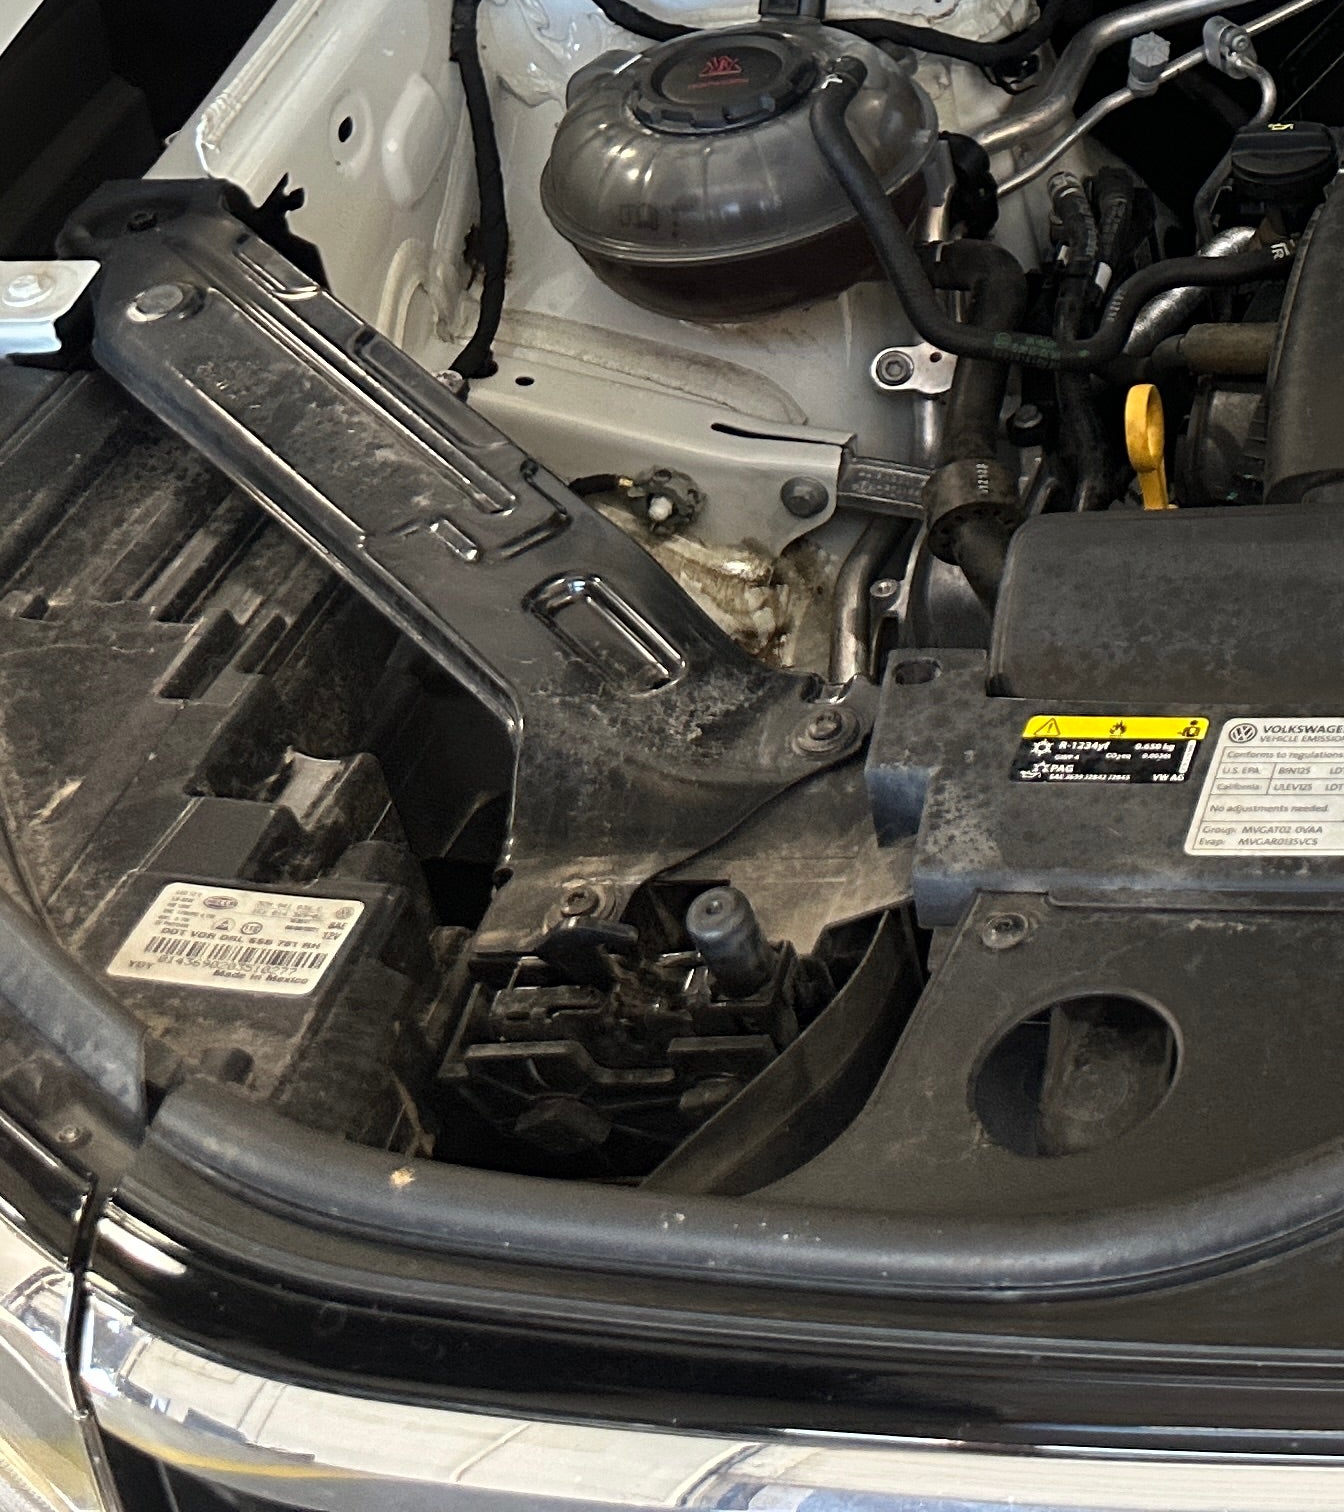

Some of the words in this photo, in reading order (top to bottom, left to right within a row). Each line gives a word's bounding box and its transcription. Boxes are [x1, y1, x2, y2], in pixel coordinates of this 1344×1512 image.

[1260, 735, 1297, 743] VEHICLE
[1058, 740, 1111, 751] R-1234yf
[1134, 743, 1162, 751] 0.650
[1163, 743, 1175, 752] kg
[1227, 751, 1274, 759] Conforms
[1277, 751, 1287, 759] to
[1050, 763, 1074, 773] PAG
[1152, 773, 1168, 782] VW
[1169, 773, 1185, 782] AG
[1325, 783, 1344, 791] LDT
[1210, 804, 1224, 812] No
[1226, 804, 1289, 814] adjustments
[161, 928, 187, 936] DOT
[191, 931, 217, 939] VOR
[212, 969, 247, 980] Made
[249, 973, 263, 981] in
[265, 974, 309, 985] Mexico
